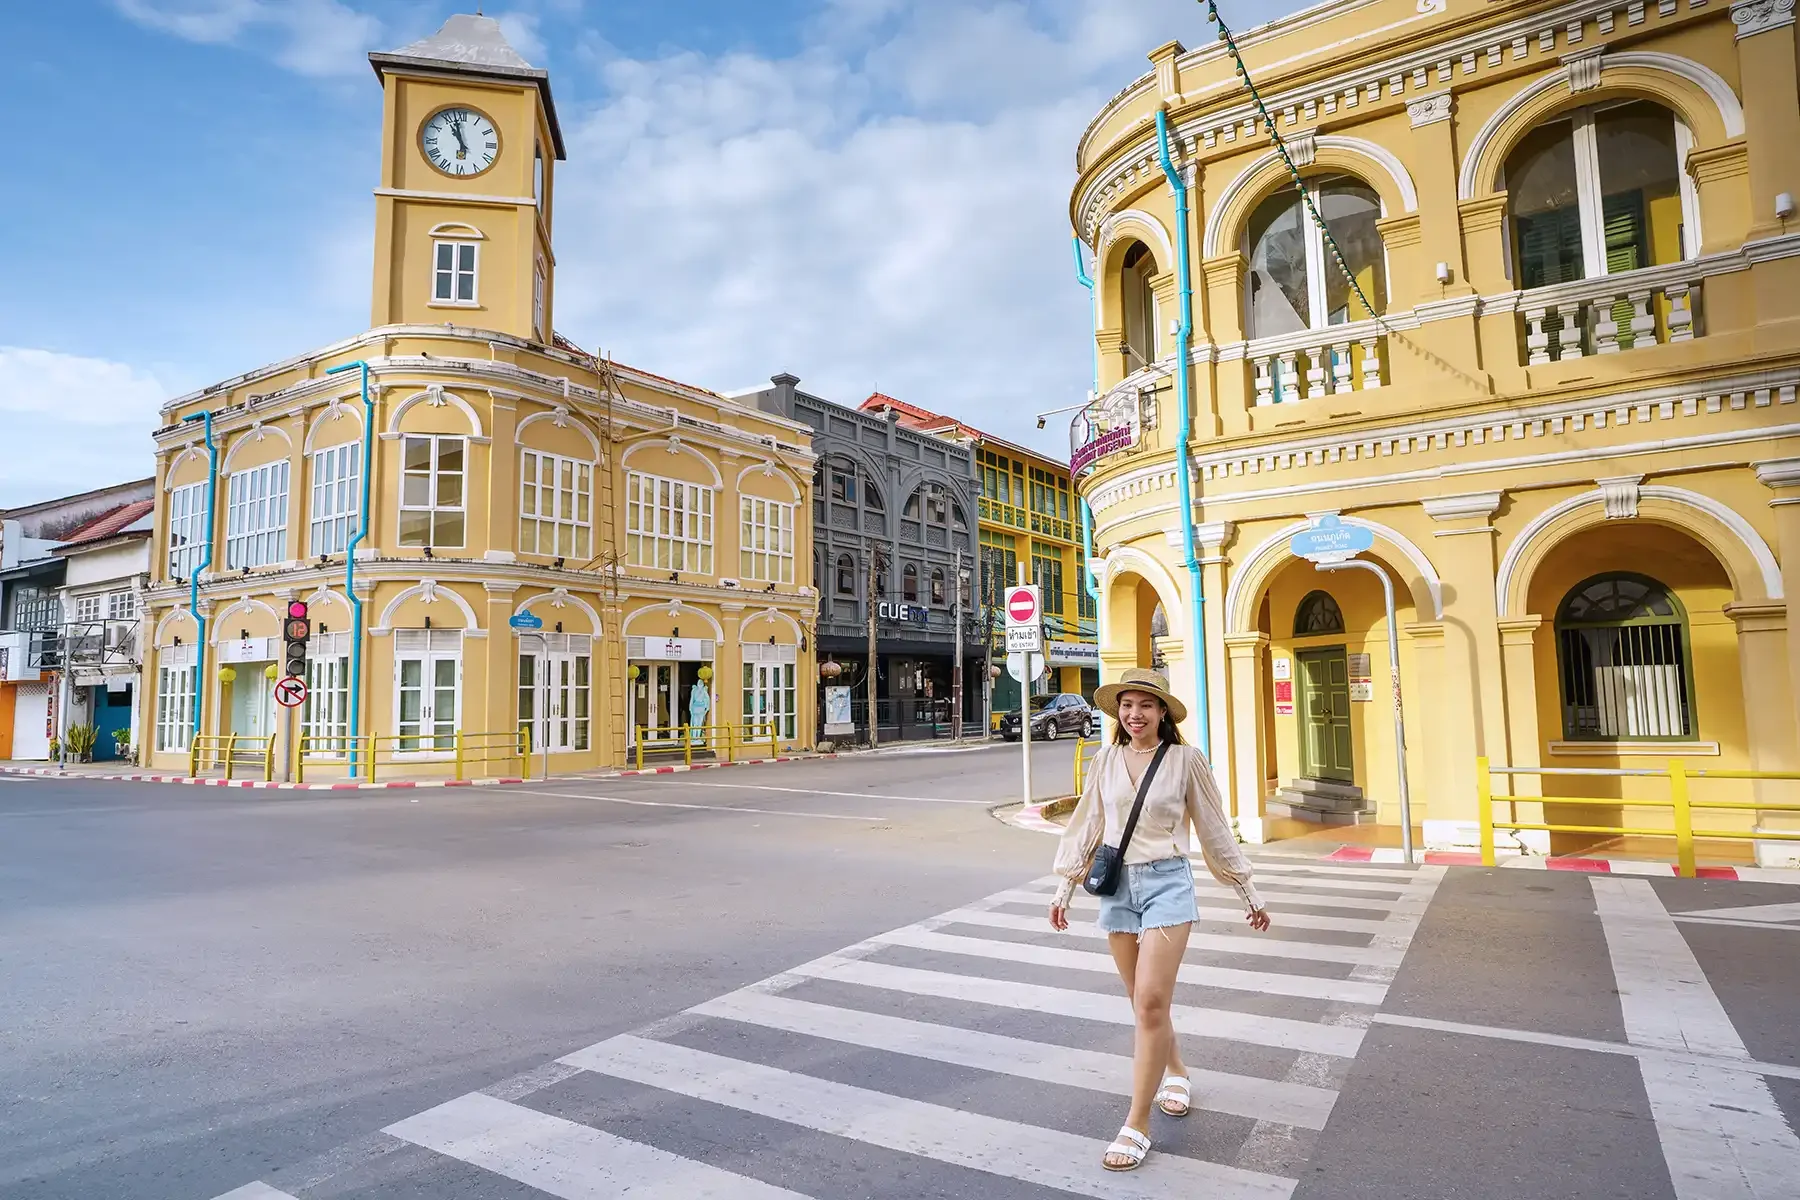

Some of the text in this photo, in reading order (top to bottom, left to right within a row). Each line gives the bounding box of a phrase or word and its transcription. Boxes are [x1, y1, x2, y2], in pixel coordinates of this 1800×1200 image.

[441, 112, 453, 124] XI
[474, 117, 480, 125] I
[429, 123, 442, 132] X
[481, 128, 493, 136] II
[425, 136, 438, 145] IX
[1097, 436, 1132, 456] MUSEUM
[293, 623, 305, 639] 12
[1008, 628, 1037, 640] ห้ามเข้า
